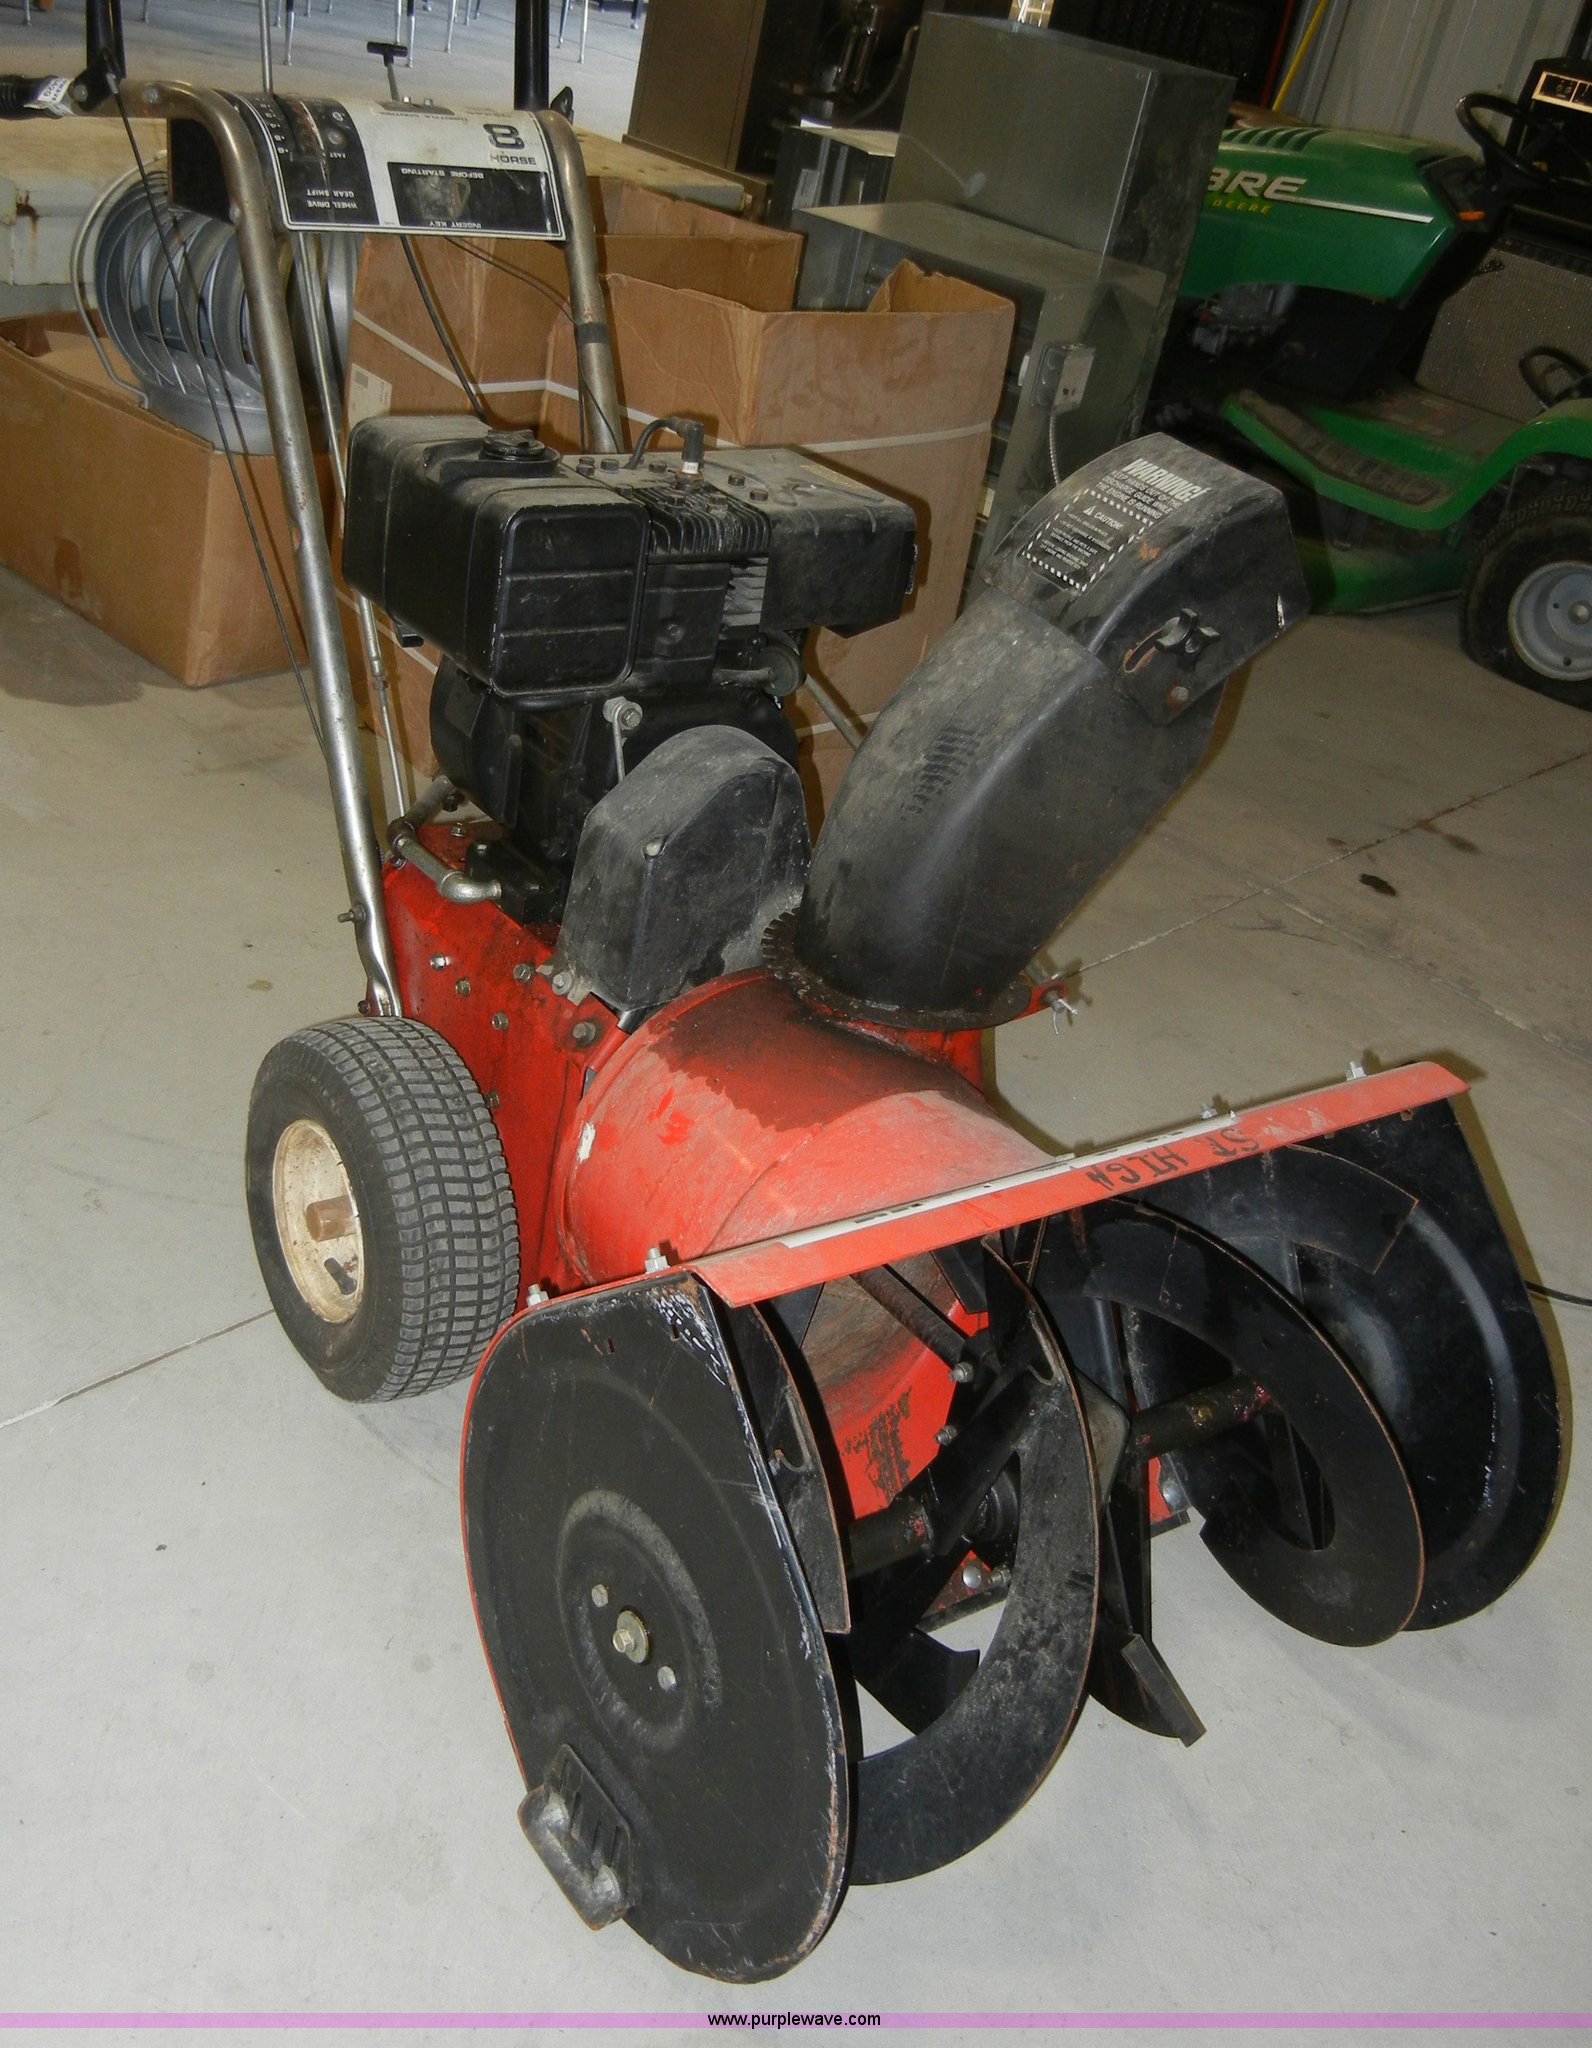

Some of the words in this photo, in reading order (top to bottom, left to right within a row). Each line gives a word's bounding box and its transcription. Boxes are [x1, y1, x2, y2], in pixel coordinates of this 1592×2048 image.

[483, 124, 526, 150] 8
[490, 155, 536, 166] HORSE
[401, 168, 445, 177] STARTING
[450, 170, 484, 180] BEFORE
[306, 188, 330, 197] SHIFT
[334, 188, 354, 198] GEAR
[308, 200, 330, 208] DRIVE
[334, 200, 358, 209] WHEEL
[1212, 199, 1272, 214] DEERE
[429, 220, 448, 228] KEY
[451, 221, 482, 229] INSERT
[1122, 458, 1212, 502] WARNING!
[1102, 475, 1136, 495] DISCHARGE
[1134, 492, 1154, 504] GUIDE
[1152, 502, 1173, 514] WHILE
[1112, 470, 1128, 480] KEEP
[1126, 477, 1148, 490] HANDS
[1145, 488, 1160, 497] OUT
[1168, 499, 1182, 509] THE
[1096, 482, 1110, 491] THE
[1106, 488, 1130, 501] ENGINE
[1134, 501, 1162, 519] RUNNING
[1094, 512, 1123, 530] CAUTION!
